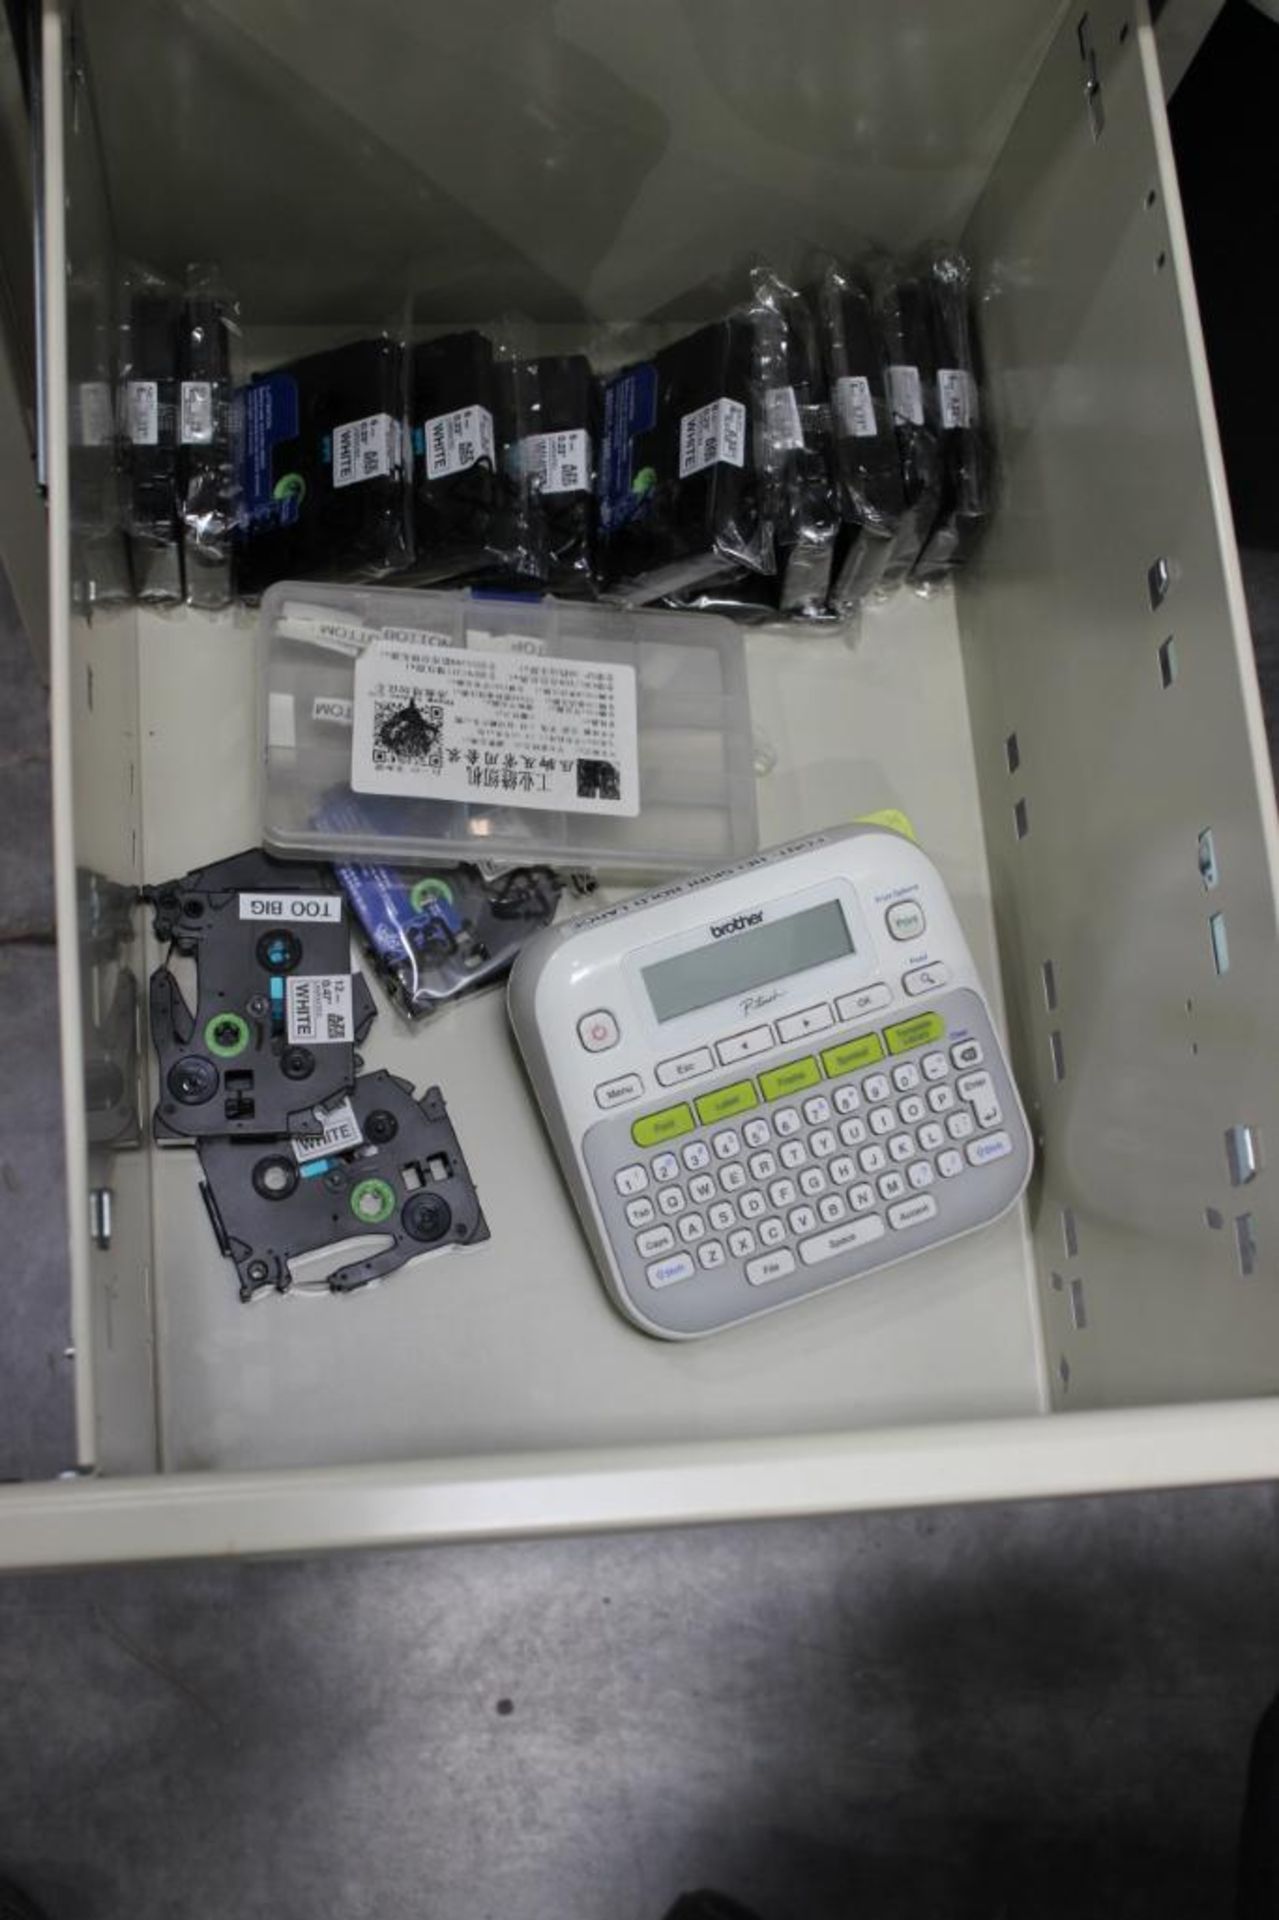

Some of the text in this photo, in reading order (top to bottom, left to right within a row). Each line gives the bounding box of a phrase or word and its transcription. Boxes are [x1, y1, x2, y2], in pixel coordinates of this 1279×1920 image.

[340, 430, 351, 478] WHITE
[432, 423, 446, 470] WHITE
[465, 765, 552, 792] 工业缝纫机
[250, 900, 331, 918] TOO BIG
[710, 910, 764, 938] brother
[296, 984, 310, 1035] WHITE
[606, 1085, 634, 1099] Menu
[676, 1063, 694, 1075] Esc
[633, 1208, 649, 1218] Tab
[667, 1196, 678, 1208] Q
[698, 1183, 710, 1196] W
[730, 1172, 740, 1184] E
[760, 1160, 770, 1172] R
[790, 1149, 800, 1161] T
[820, 1138, 828, 1149] Y
[850, 1126, 860, 1139] U
[908, 1104, 918, 1116] O
[938, 1093, 946, 1105] P
[691, 1154, 699, 1166] 3
[646, 1132, 937, 1250] Caps A S D F G H J K L
[708, 1250, 718, 1262] Z
[738, 1238, 747, 1250] X
[768, 1226, 778, 1239] C
[798, 1215, 807, 1227] V
[828, 1204, 838, 1216] B
[856, 1192, 868, 1205] N
[886, 1180, 898, 1194] M
[764, 1204, 928, 1274] File Space Accent
